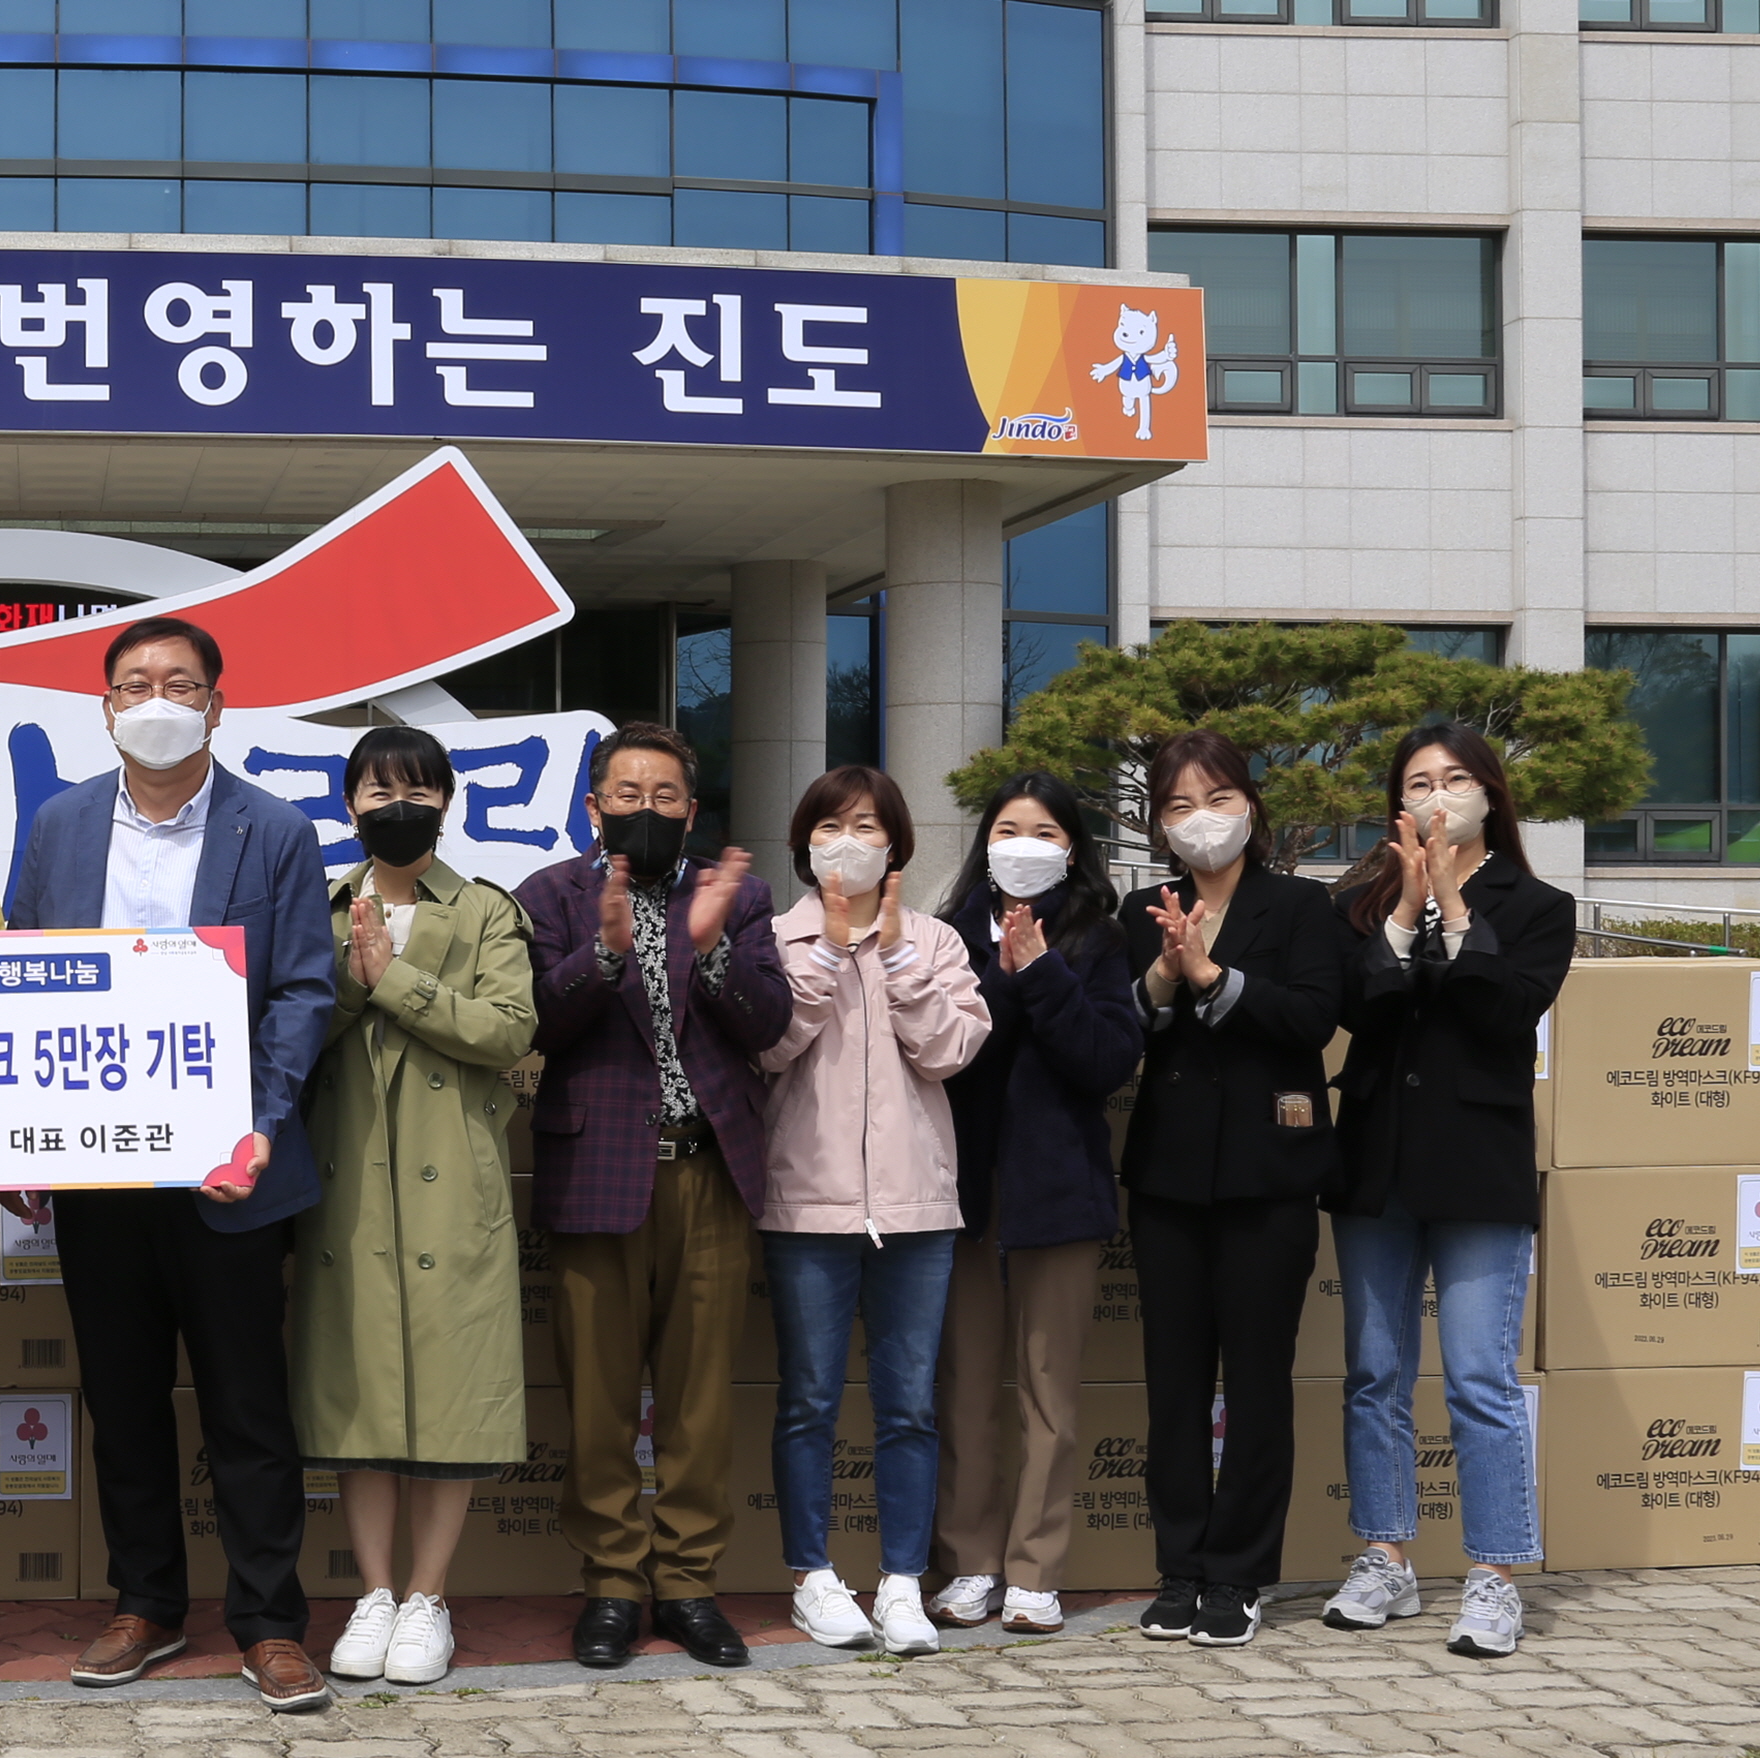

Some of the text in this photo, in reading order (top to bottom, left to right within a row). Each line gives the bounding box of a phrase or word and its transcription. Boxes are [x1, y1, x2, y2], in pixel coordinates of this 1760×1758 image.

[633, 294, 882, 415] 진도
[991, 416, 1064, 441] Jindo
[1657, 1017, 1696, 1036] eco
[34, 1023, 131, 1092] 5만장
[146, 1021, 217, 1090] 기탁
[1652, 1037, 1731, 1059] Dream
[1607, 1069, 1760, 1087] 에코드림 방역마스크(KF9
[1651, 1090, 1731, 1108] 화이트 (대형)
[10, 1126, 68, 1154] 대표
[79, 1123, 175, 1153] 이준관
[1645, 1218, 1685, 1238] eco
[1640, 1239, 1720, 1260] Dream
[1595, 1272, 1648, 1289] 에코드림
[1639, 1292, 1719, 1309] 화이트 (대형)
[1647, 1419, 1686, 1438] eco
[1094, 1437, 1136, 1457] eco
[1642, 1438, 1721, 1460] Dream
[1596, 1472, 1649, 1490] 에코드림
[1641, 1491, 1721, 1509] 화이트 (대형)
[1418, 1502, 1453, 1520] (대형)
[497, 1518, 541, 1536] 화이트
[1087, 1513, 1129, 1530] 화이트
